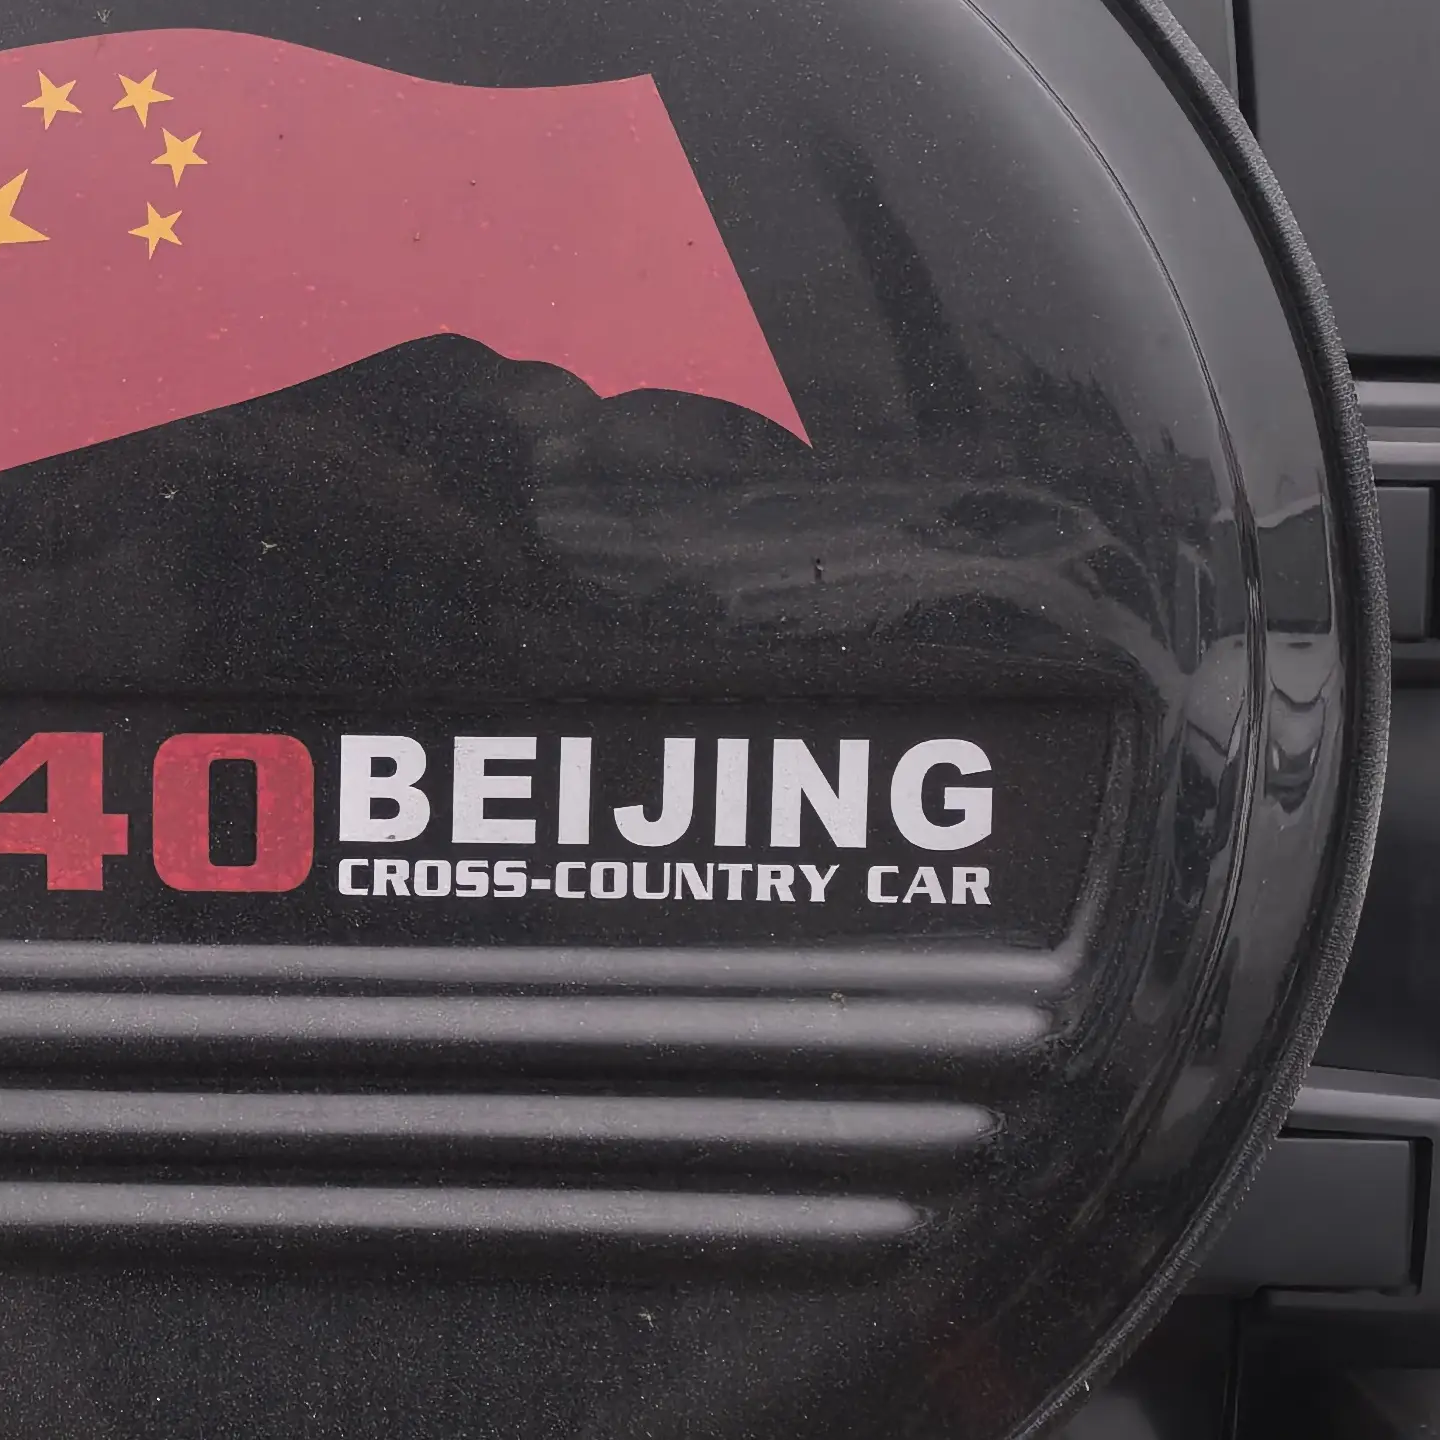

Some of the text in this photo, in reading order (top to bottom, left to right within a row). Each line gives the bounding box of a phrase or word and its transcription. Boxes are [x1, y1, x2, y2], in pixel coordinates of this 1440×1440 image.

[338, 734, 994, 851] BEIJING
[338, 858, 993, 906] CROSS-COUNTRY CAR
